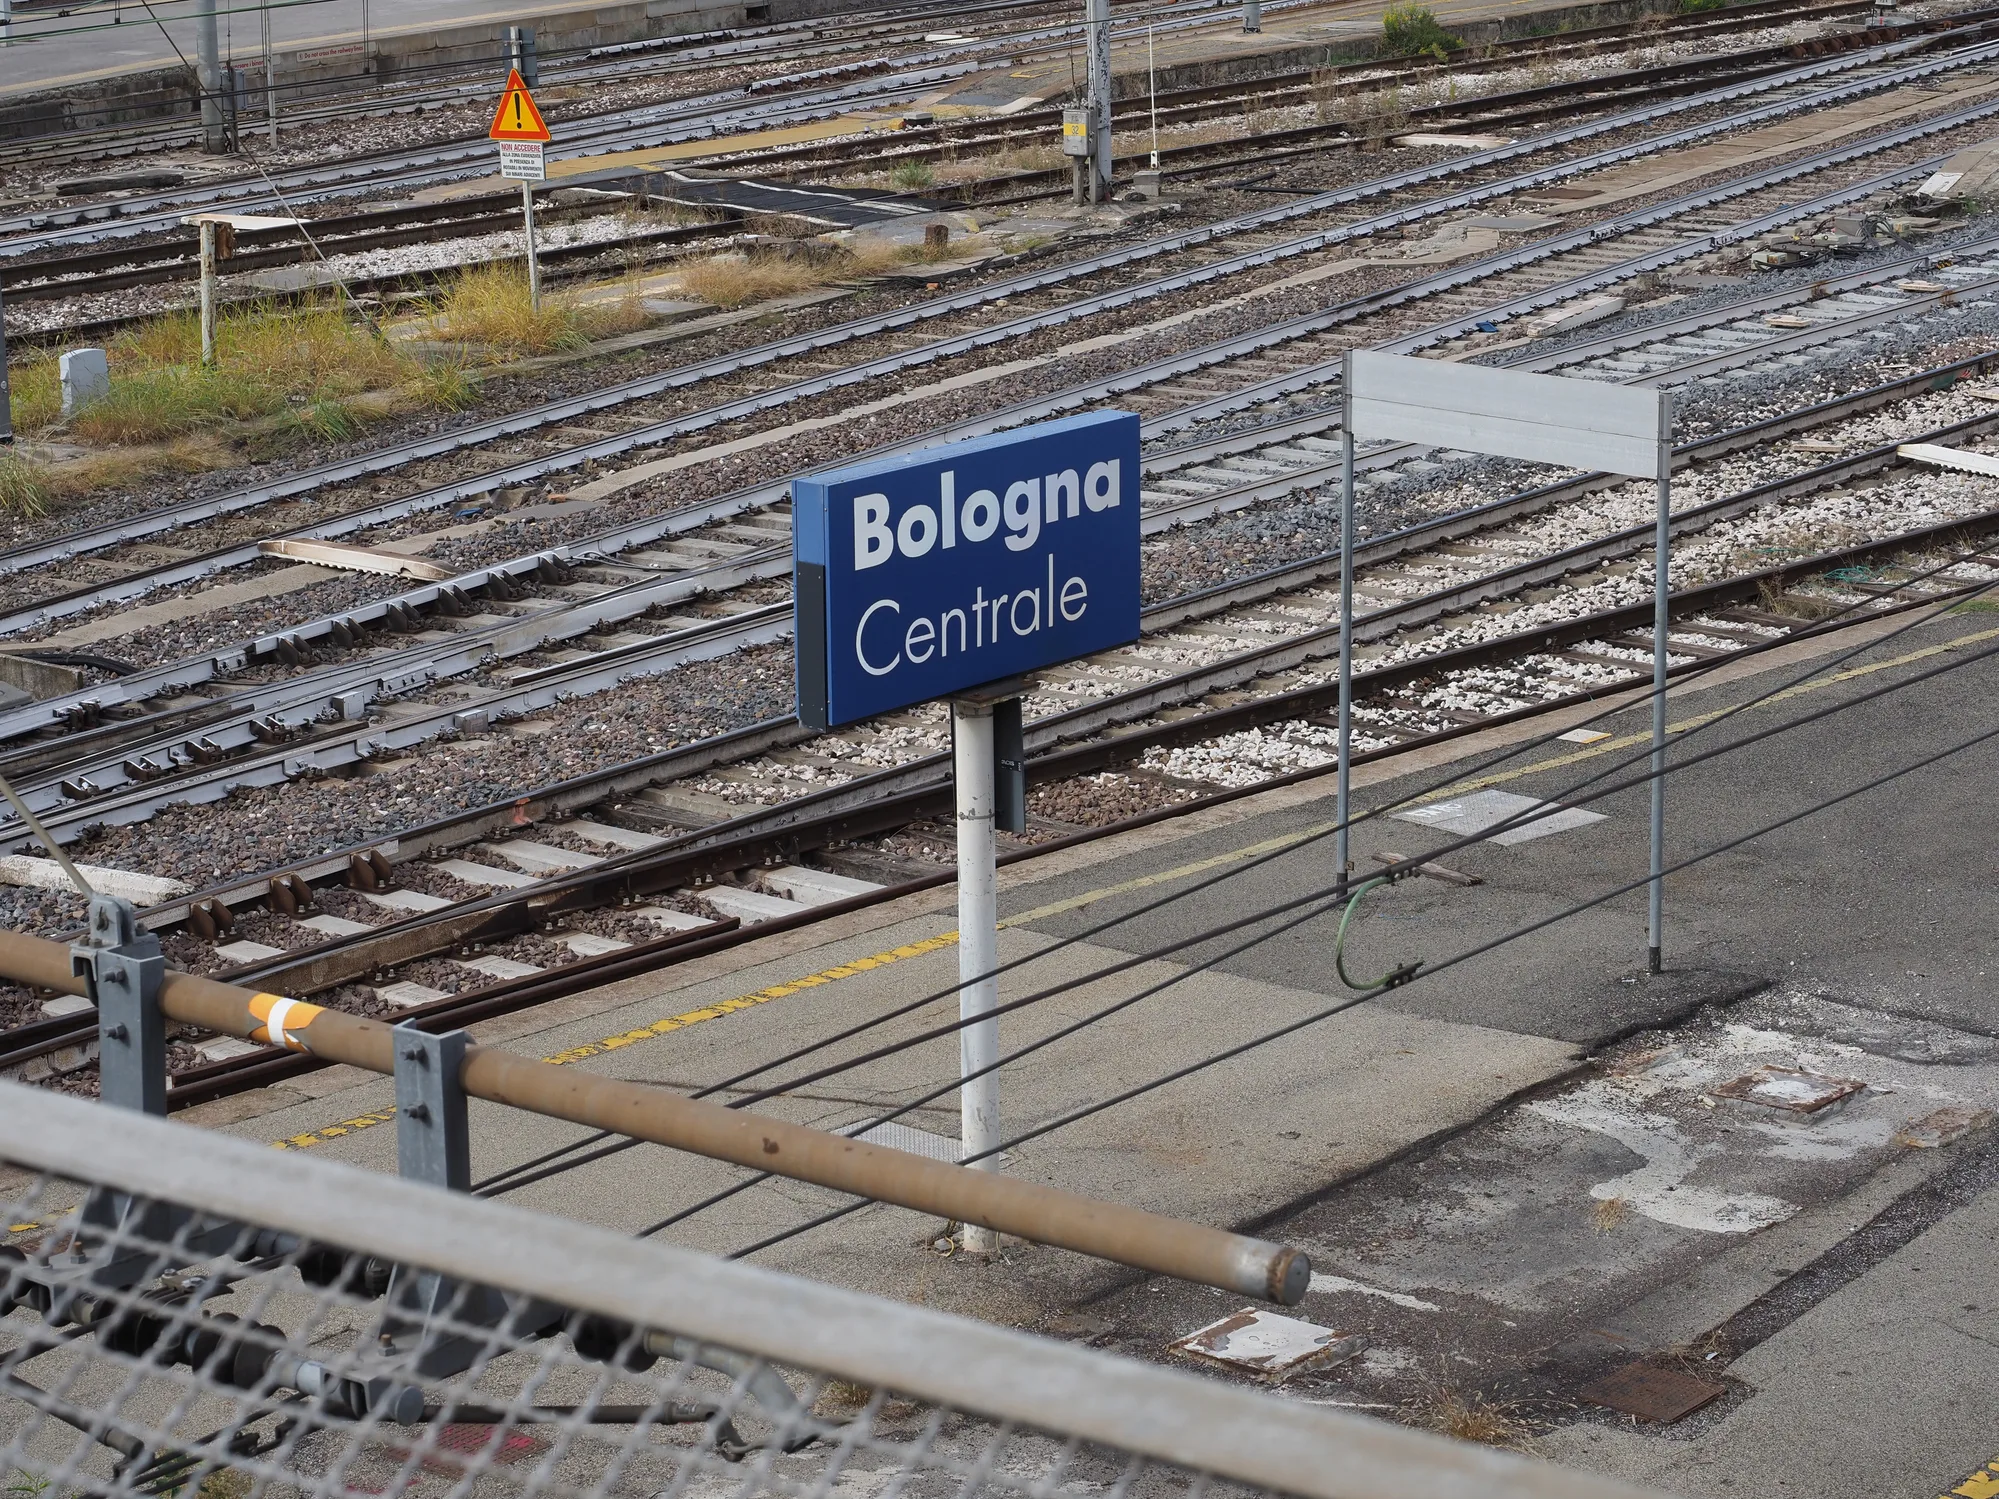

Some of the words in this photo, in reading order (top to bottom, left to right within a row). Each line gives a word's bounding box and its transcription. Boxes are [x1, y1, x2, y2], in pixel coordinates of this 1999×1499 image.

[501, 143, 512, 151] NON
[513, 144, 541, 152] ACCEDERE
[1072, 125, 1079, 135] 32
[854, 458, 1120, 571] Bologna
[856, 554, 1087, 675] Centrale
